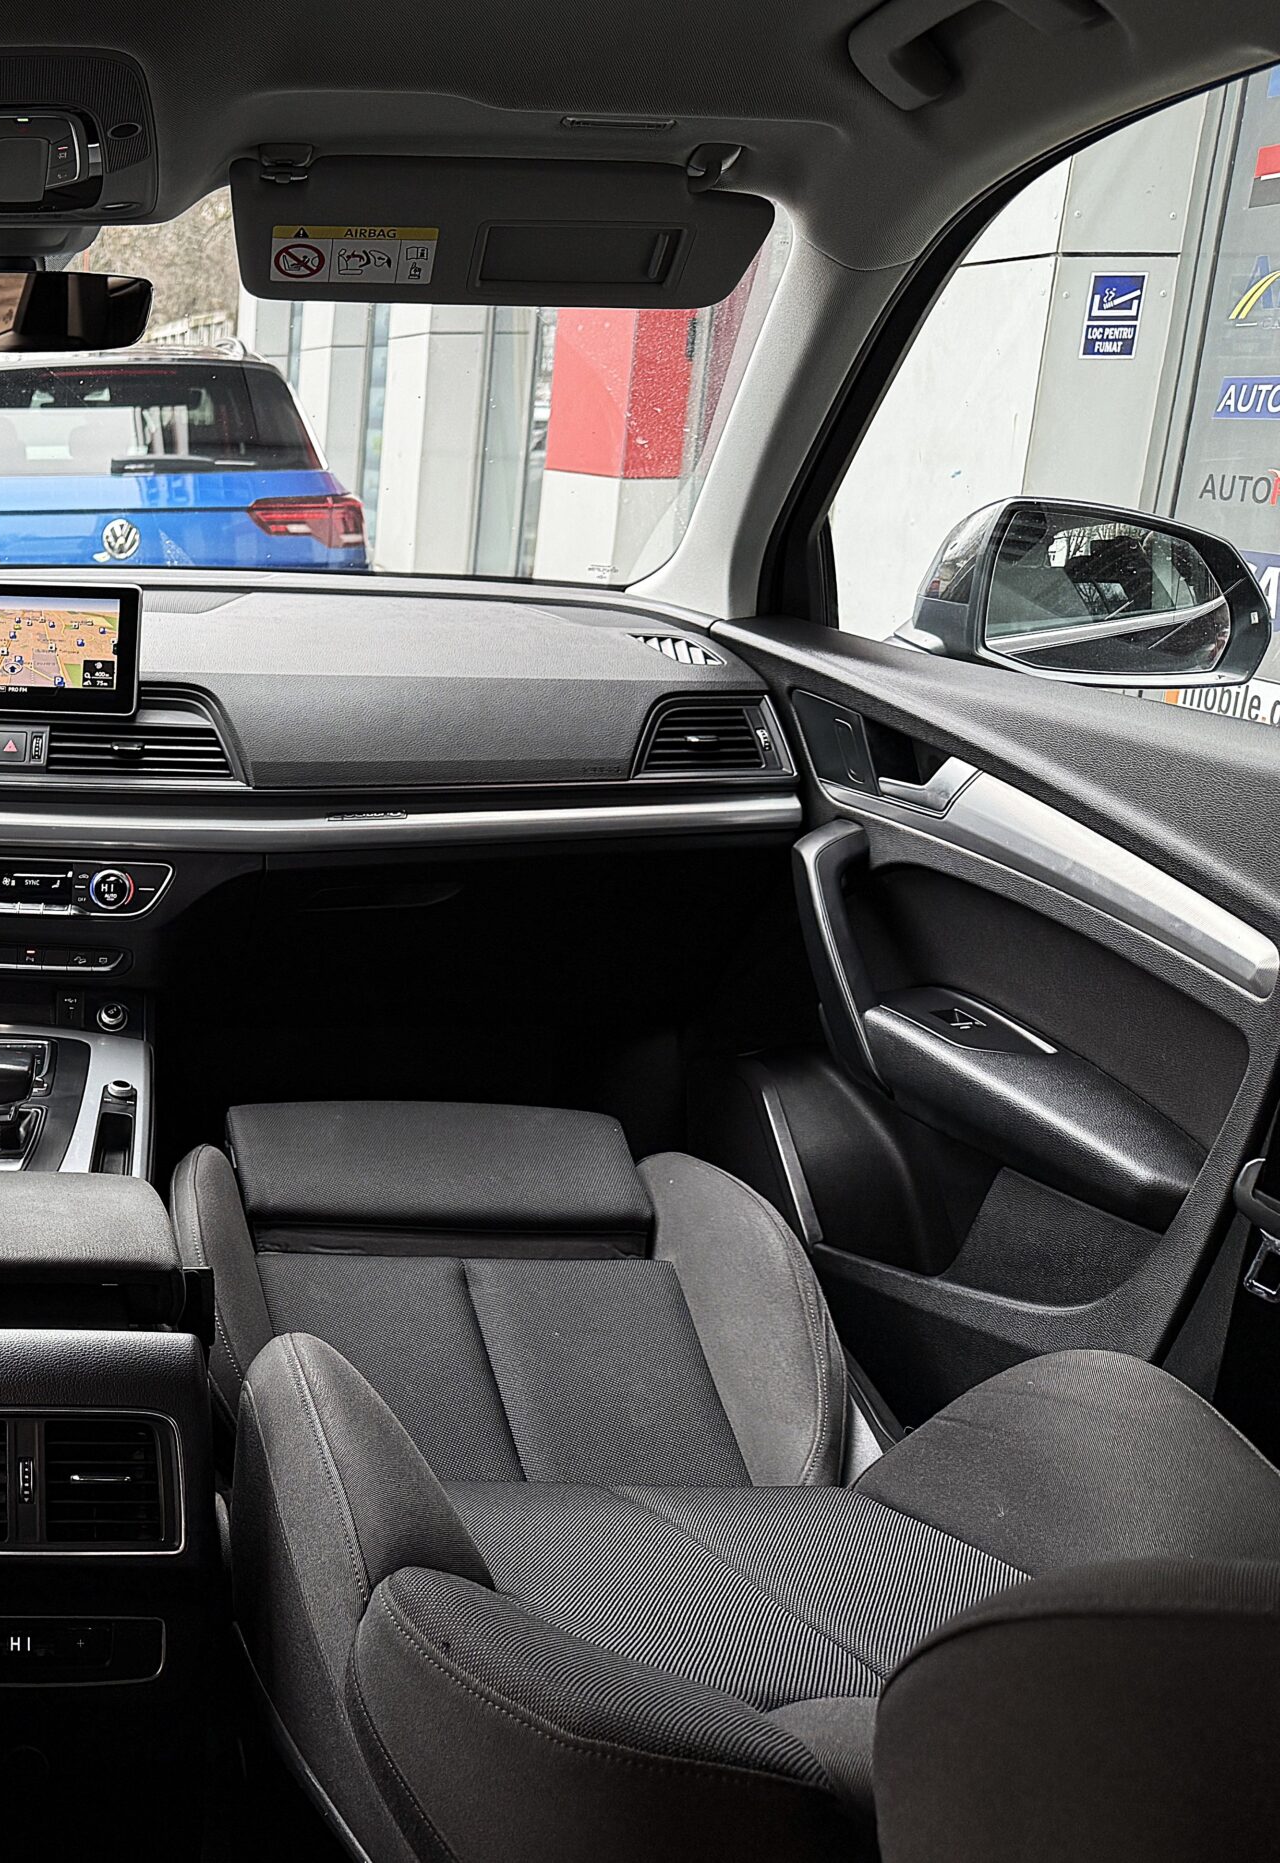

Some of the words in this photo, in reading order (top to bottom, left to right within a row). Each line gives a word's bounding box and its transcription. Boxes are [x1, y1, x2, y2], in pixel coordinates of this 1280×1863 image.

[344, 228, 397, 239] AIRBAG
[1087, 327, 1102, 339] LOC
[1103, 327, 1134, 340] PENTRU
[1094, 341, 1123, 353] FUMAT
